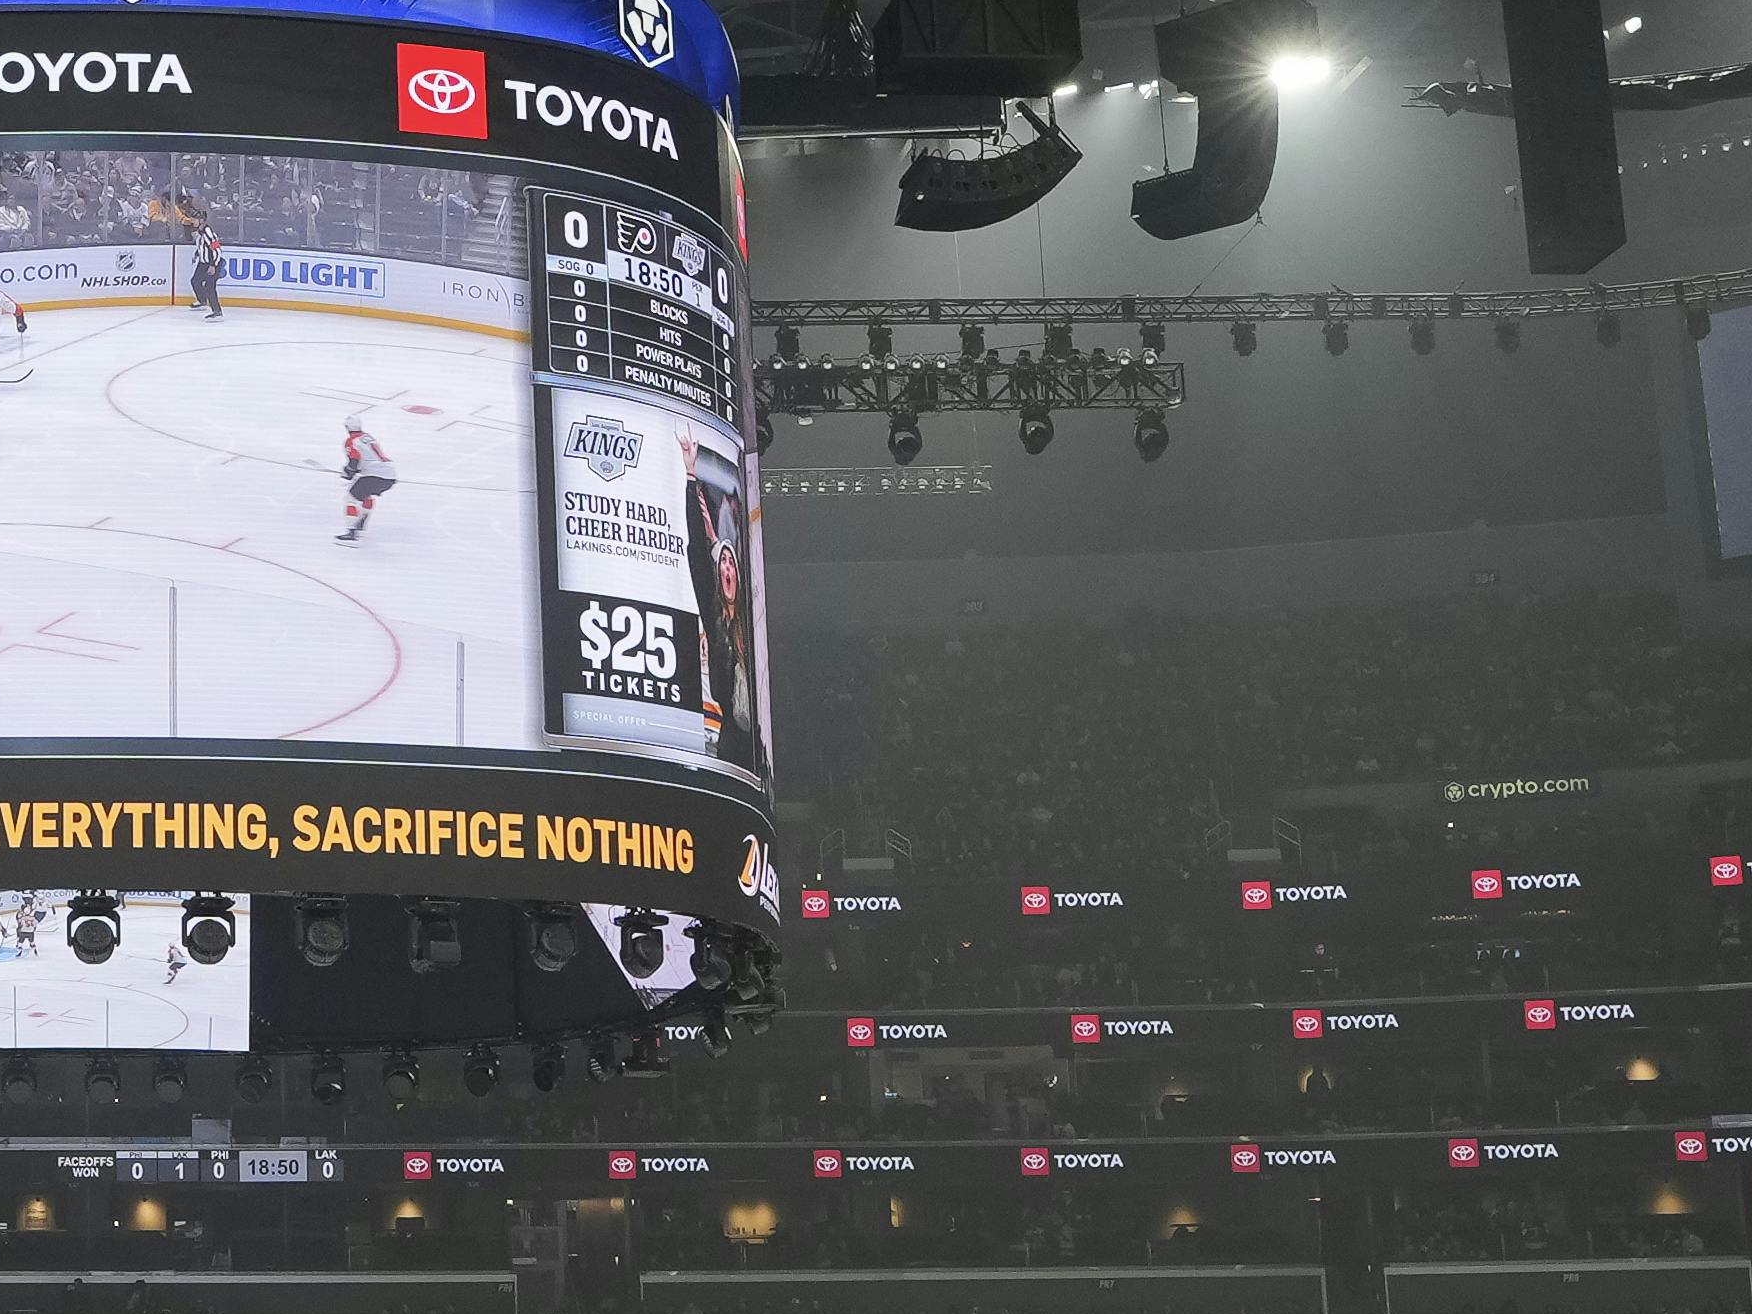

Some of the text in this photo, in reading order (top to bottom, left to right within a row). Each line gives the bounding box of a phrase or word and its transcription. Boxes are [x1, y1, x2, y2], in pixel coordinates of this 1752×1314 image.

[504, 80, 680, 161] TOYOTA
[564, 211, 589, 249] 0
[282, 262, 379, 291] LIGHT
[624, 257, 683, 296] 18:50
[651, 300, 688, 323] BLOCKS
[573, 427, 639, 463] KINGS
[565, 491, 671, 531] STUDY HARD,
[566, 517, 684, 556] CHEER HARDER
[566, 538, 680, 569] LAKINGS.COM/STUDENT
[579, 601, 676, 680] $25
[582, 670, 681, 703] TICKETS
[573, 710, 615, 723] SPECIAL
[1467, 774, 1590, 800] crypto.com
[293, 805, 525, 859] SACRIFICE
[537, 816, 694, 874] NOTHING
[1508, 873, 1581, 889] TOYOTA
[1055, 892, 1123, 906] TOYOTA
[1277, 886, 1347, 901] TOYOTA
[1327, 1014, 1398, 1030] TOYOTA
[1561, 1005, 1634, 1020] TOYOTA
[880, 1025, 947, 1039] TOYOTA
[1105, 1021, 1173, 1035] TOYOTA
[58, 1157, 114, 1168] FACEOFFS
[72, 1159, 299, 1178] WON 18:50
[437, 1159, 504, 1172] TOYOTA
[641, 1158, 709, 1171] TOYOTA
[846, 1157, 914, 1170] TOYOTA
